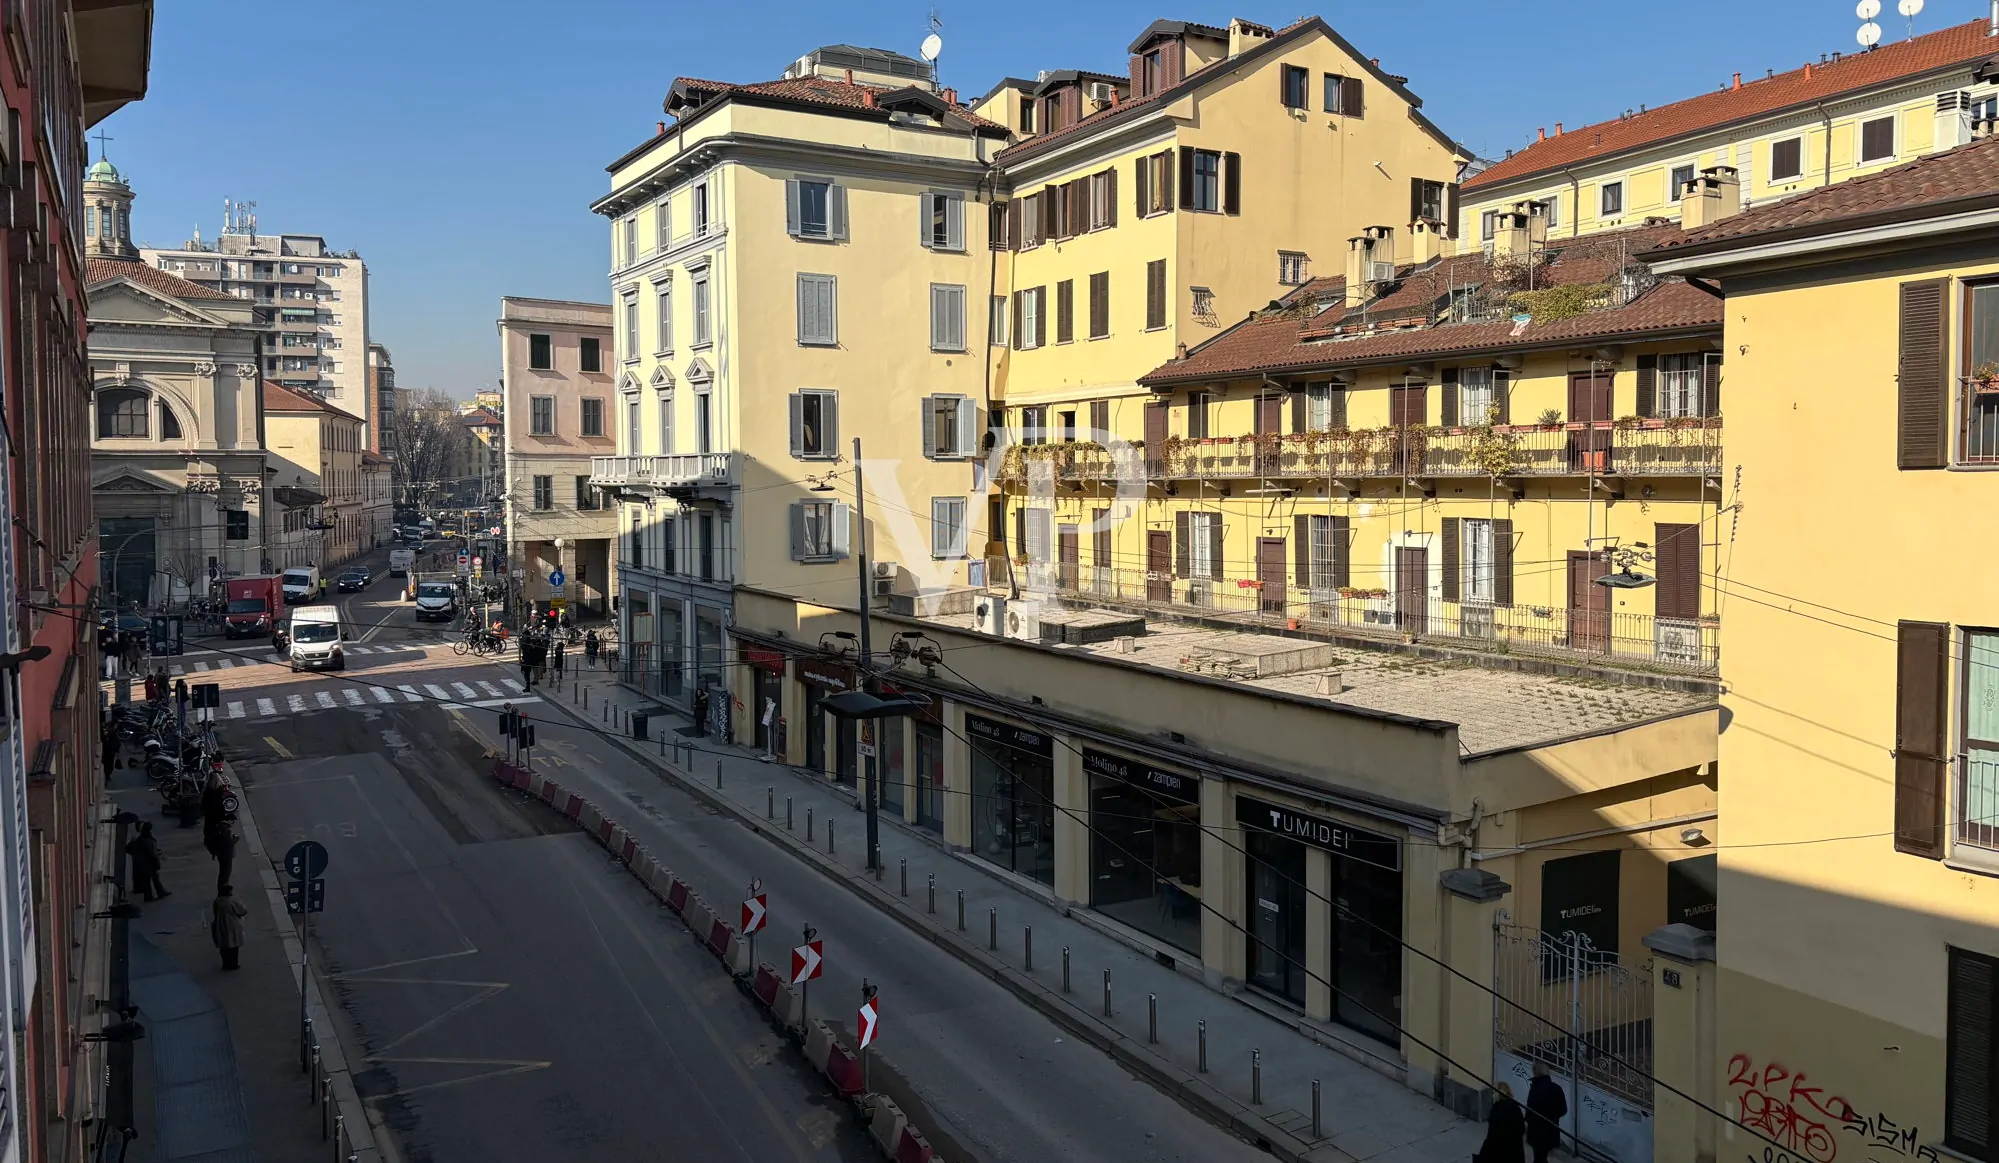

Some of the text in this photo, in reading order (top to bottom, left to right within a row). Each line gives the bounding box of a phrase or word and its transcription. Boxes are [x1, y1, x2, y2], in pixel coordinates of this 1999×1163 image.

[971, 719, 992, 734] Molino
[1090, 755, 1128, 777] Molino 48
[1269, 810, 1348, 850] TUMIDEI
[1560, 904, 1593, 919] TUMIDEI
